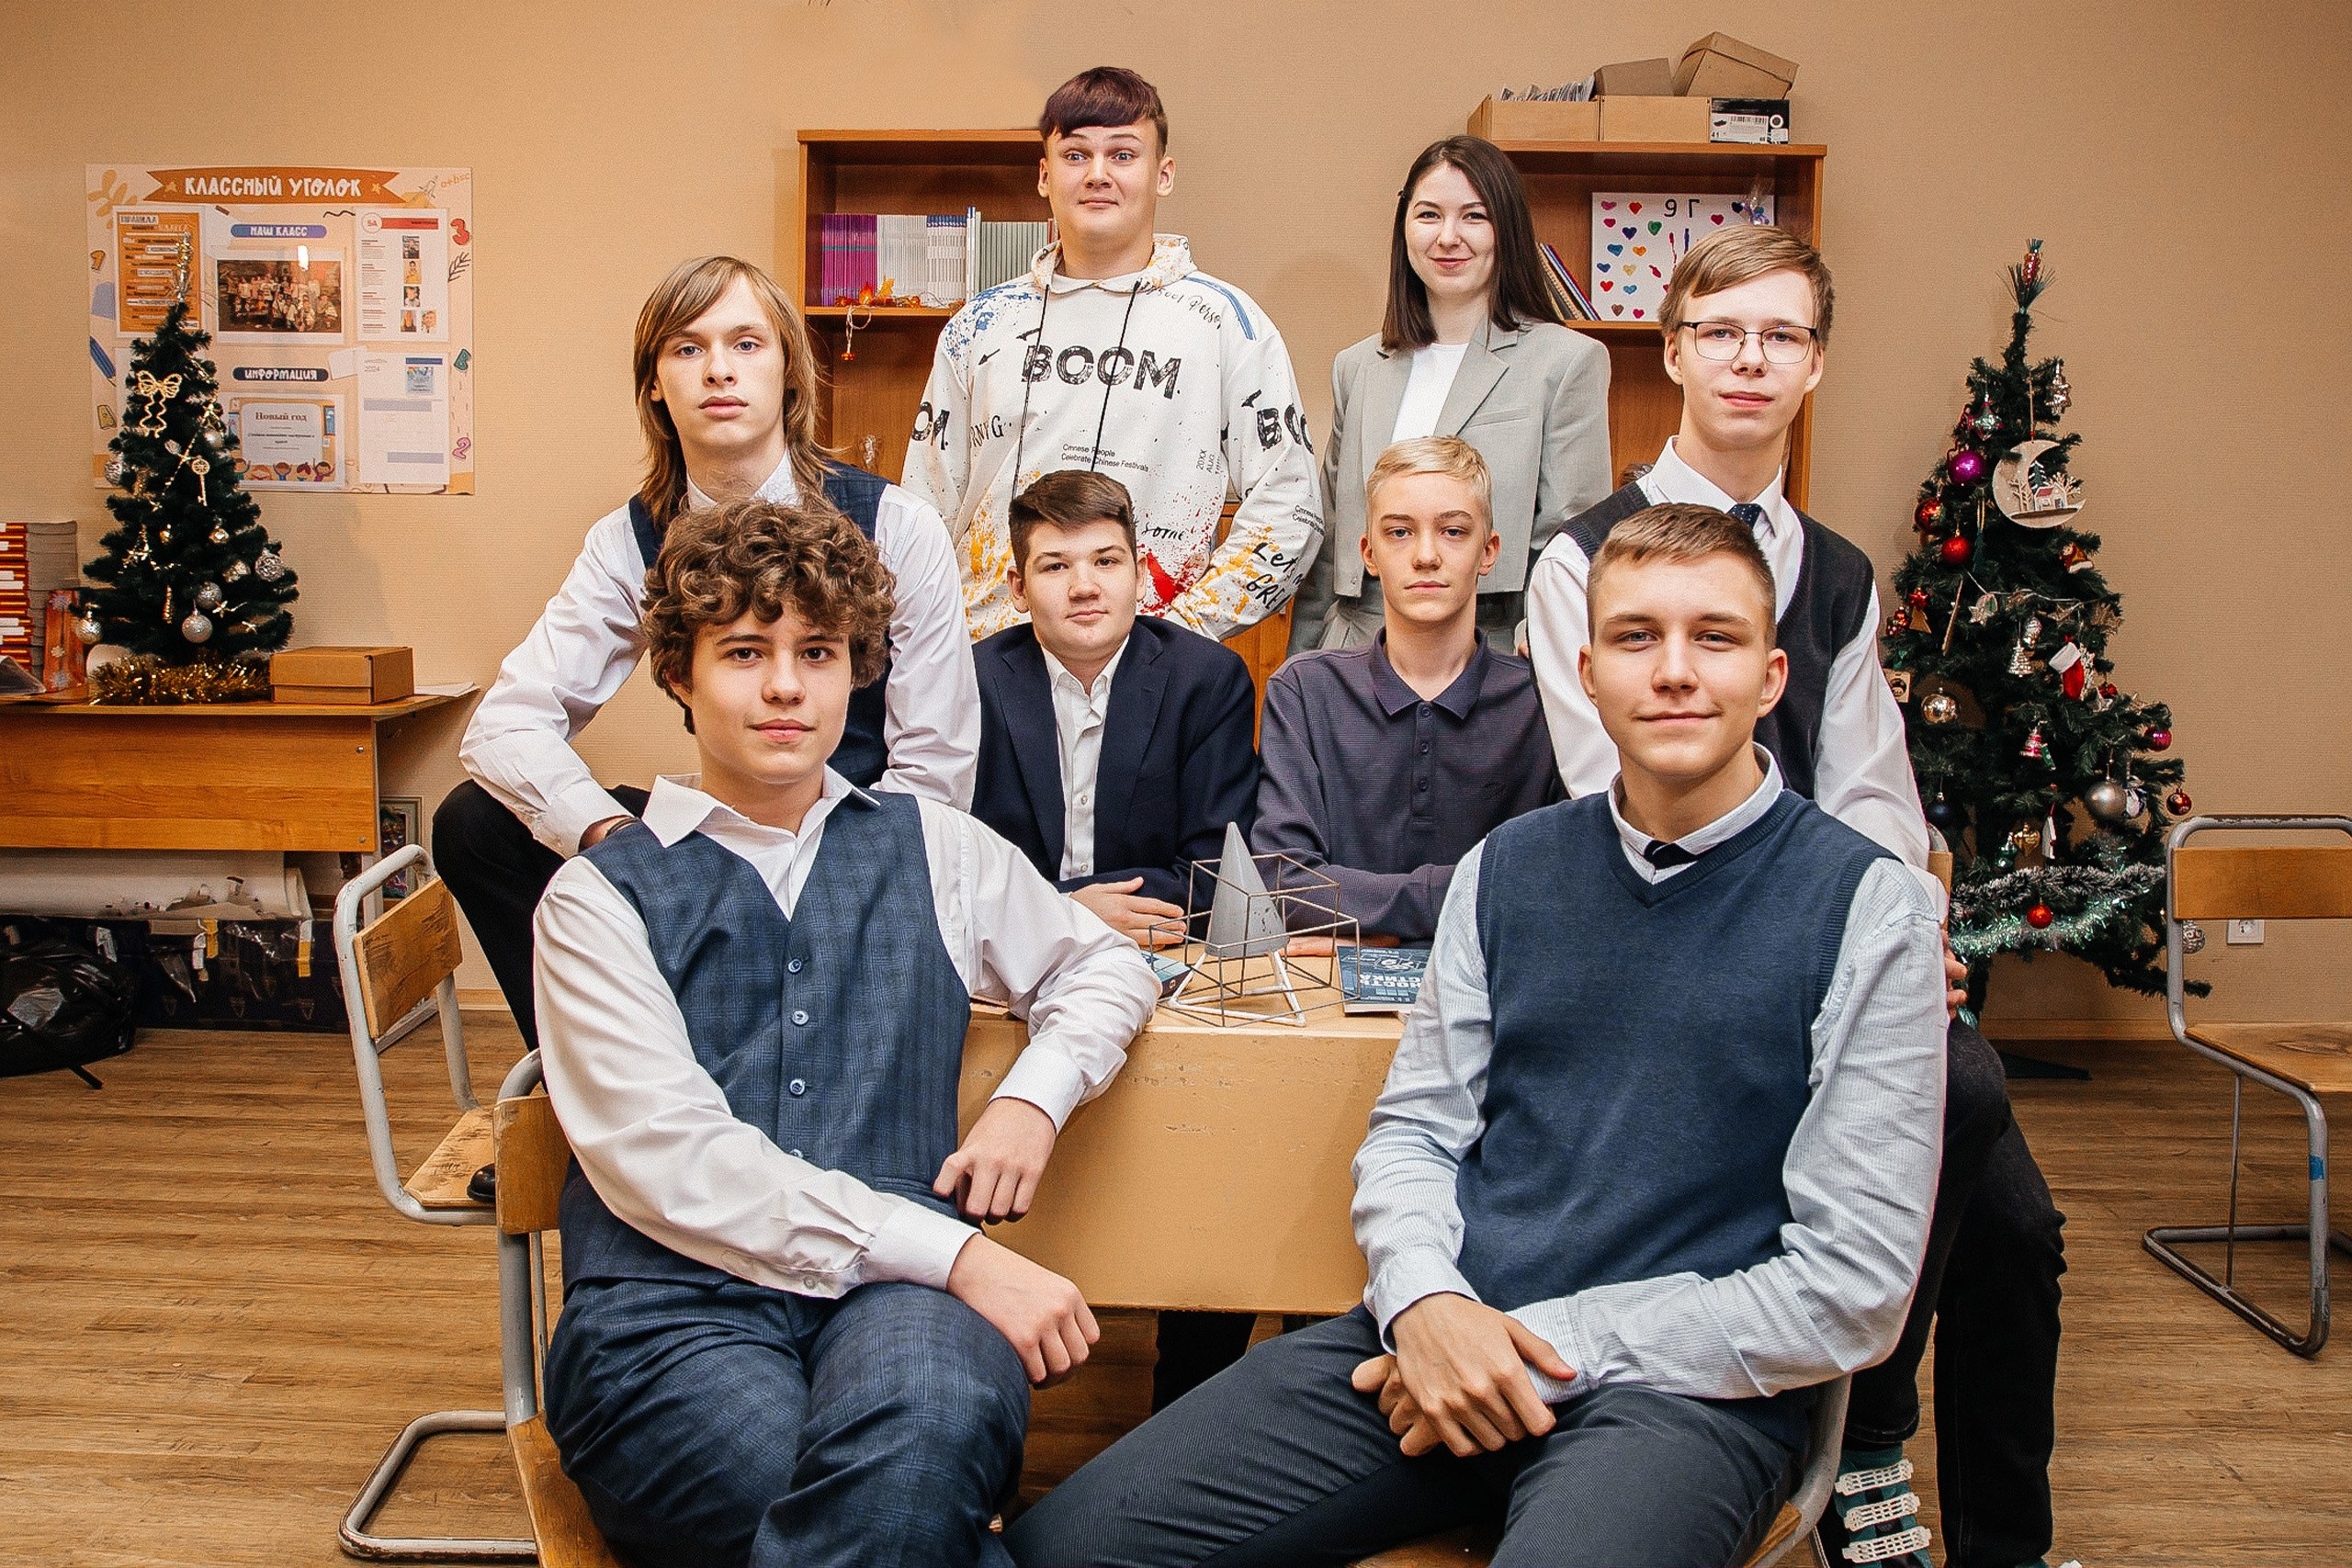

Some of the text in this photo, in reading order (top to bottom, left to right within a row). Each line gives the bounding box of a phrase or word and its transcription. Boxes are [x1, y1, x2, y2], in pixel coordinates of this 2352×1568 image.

[185, 175, 362, 197] КЛАССНЫЙ УГОЛОК
[1663, 197, 1701, 219] 9 Г
[250, 226, 308, 237] НАШ КЛАСС
[244, 368, 318, 380] ИНФОРМАЦИЯ
[1021, 344, 1182, 400] BOOM.
[255, 412, 289, 421] Новый
[1094, 457, 1120, 467] Chinese
[1121, 460, 1148, 472] Festivals
